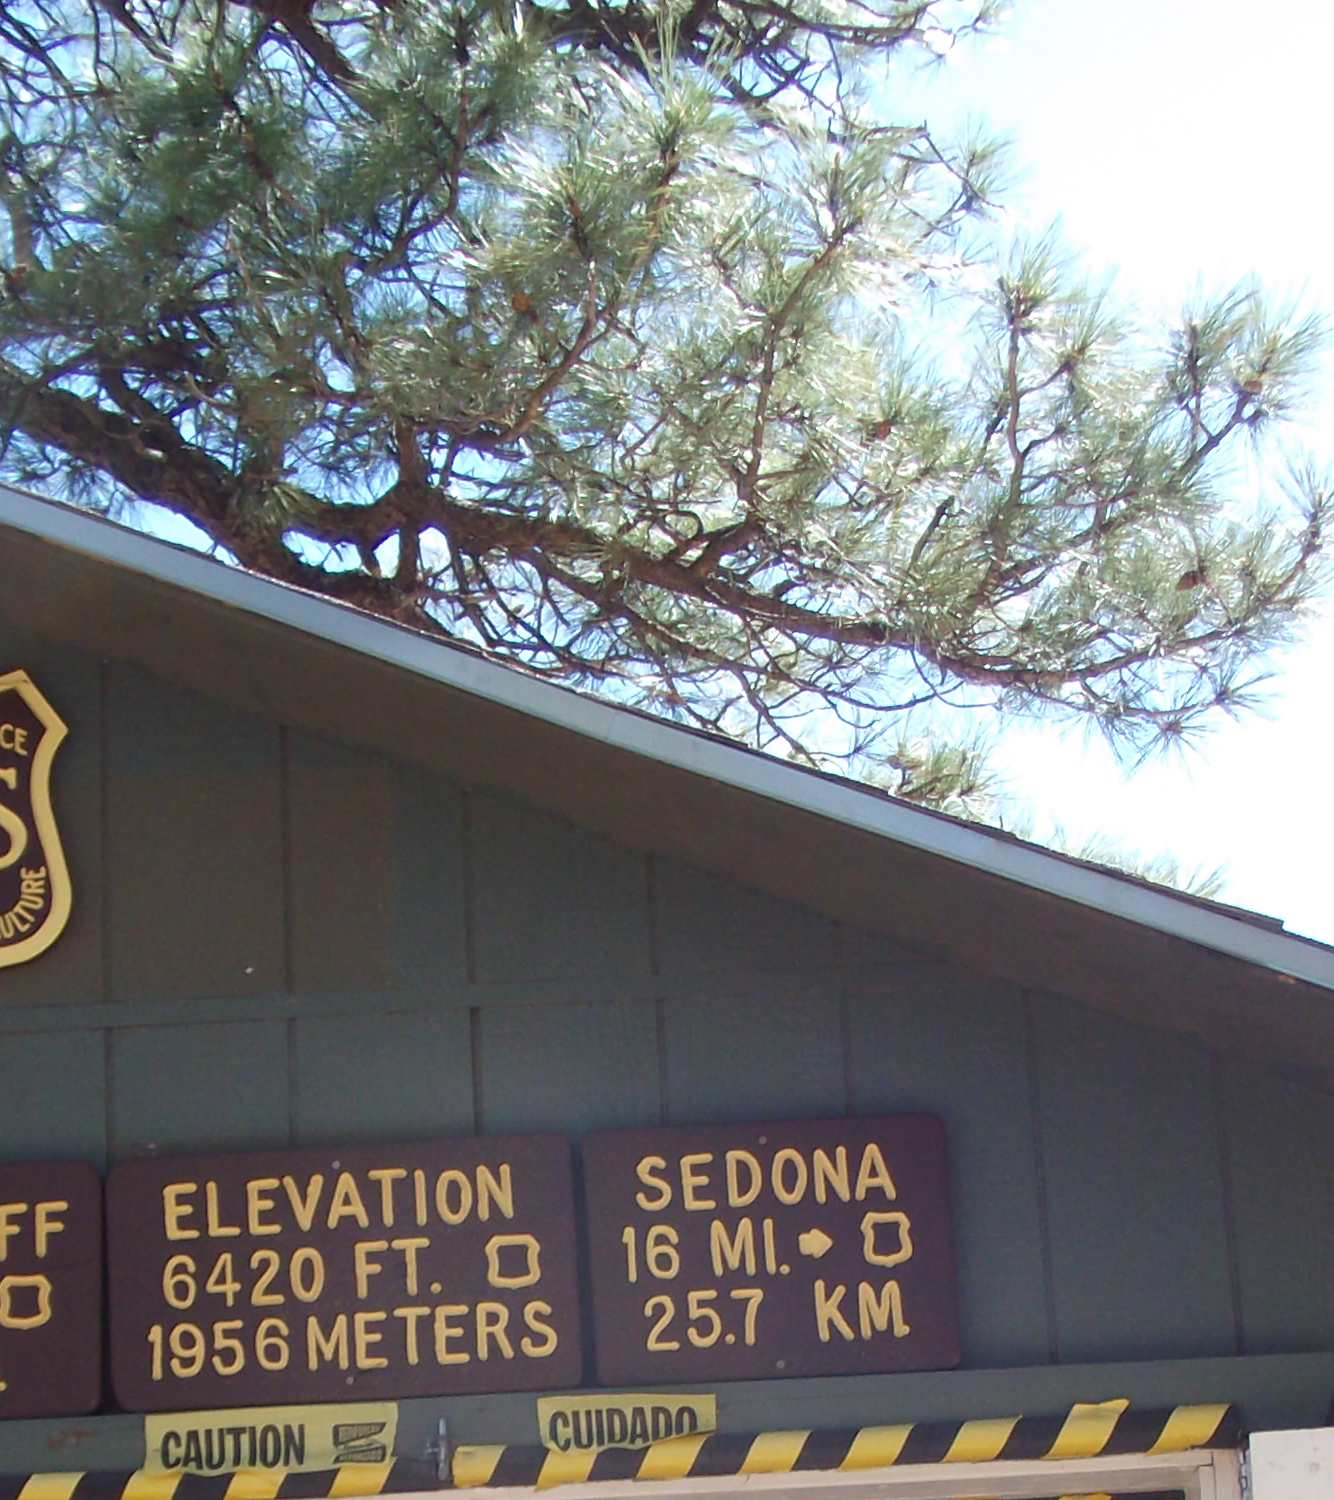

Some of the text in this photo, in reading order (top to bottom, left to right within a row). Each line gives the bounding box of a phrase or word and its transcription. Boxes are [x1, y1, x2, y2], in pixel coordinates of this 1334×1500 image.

[162, 1163, 515, 1240] ELEVATION
[635, 1142, 897, 1212] SEDONA
[162, 1237, 443, 1310] 6420 FT.
[622, 1217, 791, 1283] 16 MI.
[147, 1300, 558, 1381] 1956 METERS
[644, 1288, 764, 1351] 25.7
[161, 1424, 305, 1470] CAUTION
[549, 1406, 698, 1453] CUIDADO
